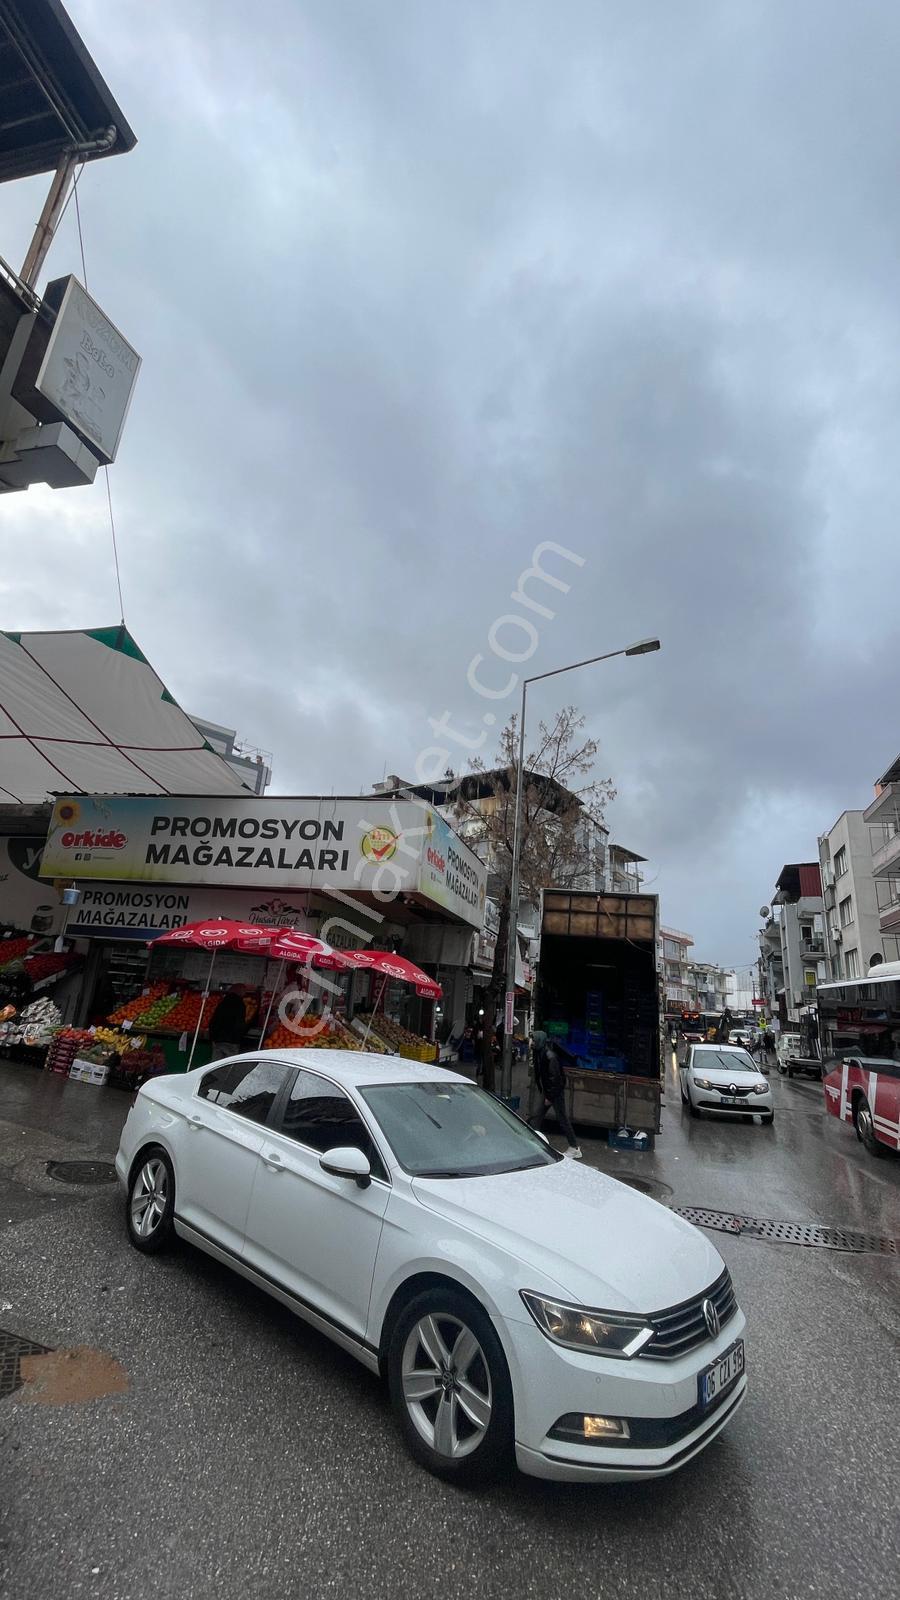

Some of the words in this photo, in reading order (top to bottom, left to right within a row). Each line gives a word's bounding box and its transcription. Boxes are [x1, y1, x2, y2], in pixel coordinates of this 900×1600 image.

[60, 827, 128, 850] orkide
[150, 816, 344, 842] PROMOSYON
[145, 840, 349, 871] MAĞAZALARI
[82, 890, 190, 910] PROMOSYON
[76, 908, 188, 929] MAĞAZALARI
